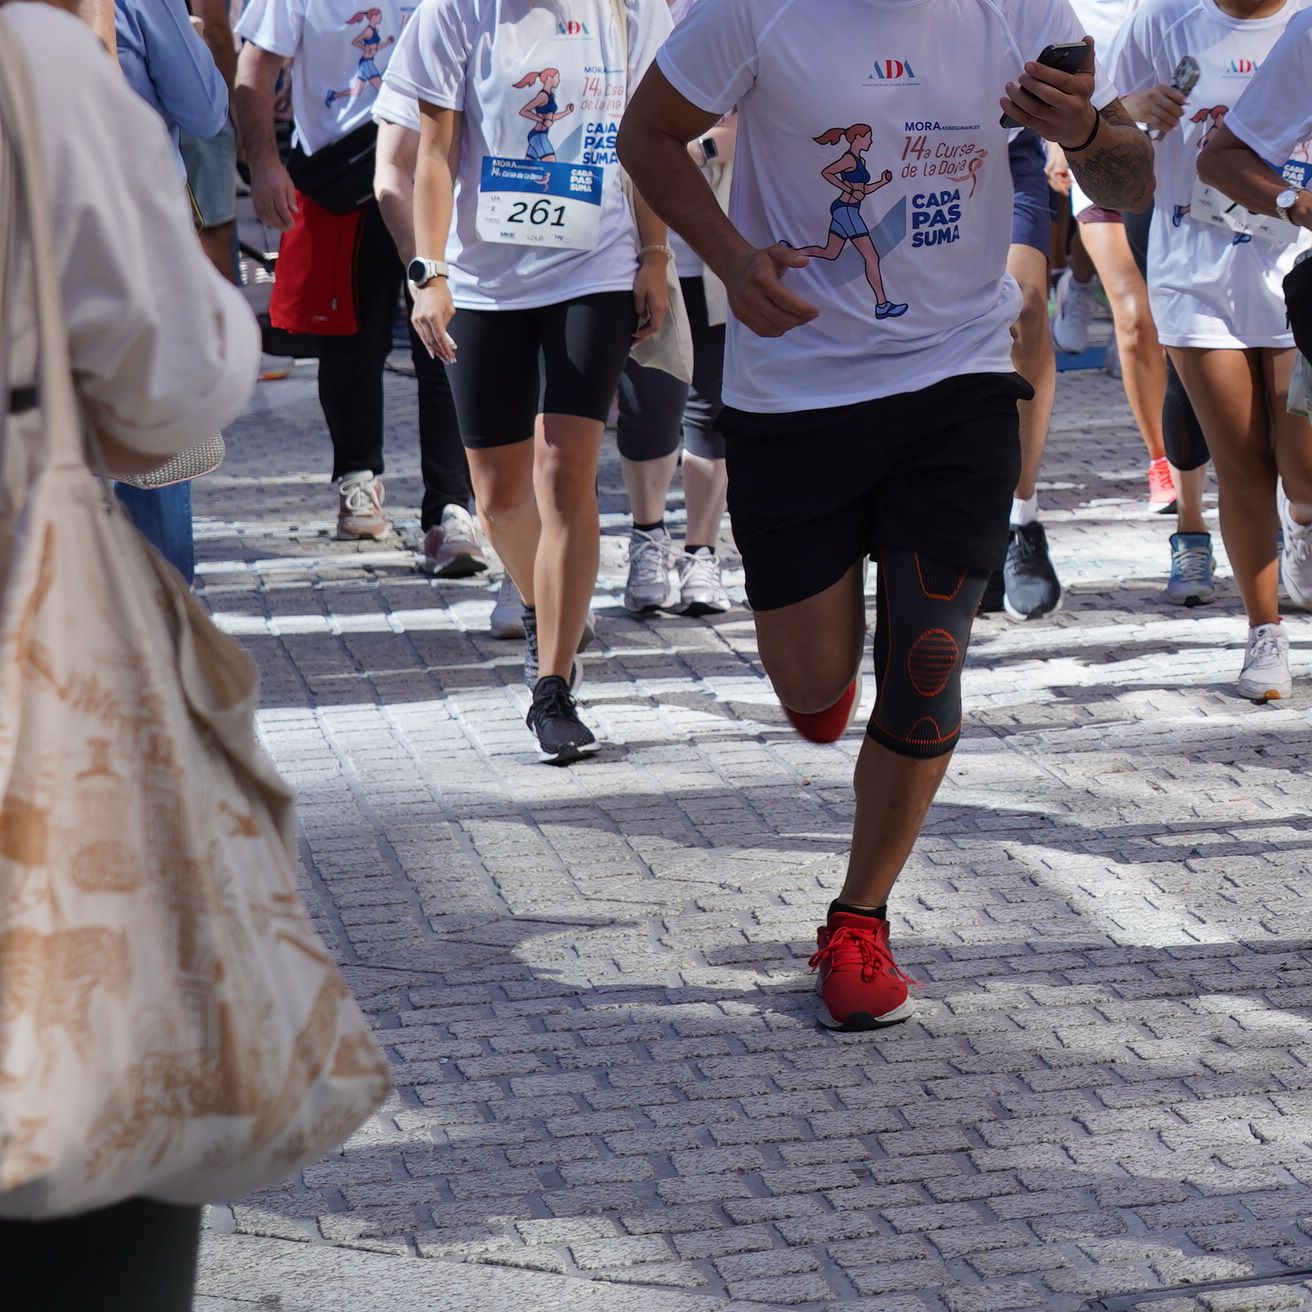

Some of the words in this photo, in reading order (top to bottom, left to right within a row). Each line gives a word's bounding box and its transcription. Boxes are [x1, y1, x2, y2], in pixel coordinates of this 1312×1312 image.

[868, 59, 916, 80] ADA
[904, 120, 940, 132] MORA
[584, 136, 617, 150] PAS
[935, 142, 976, 159] Cursa
[901, 163, 918, 178] de
[923, 161, 937, 178] la
[570, 175, 593, 186] PAS
[911, 188, 961, 209] CADA
[506, 199, 567, 227] 261
[911, 203, 962, 230] PAS
[911, 224, 960, 249] SUMA
